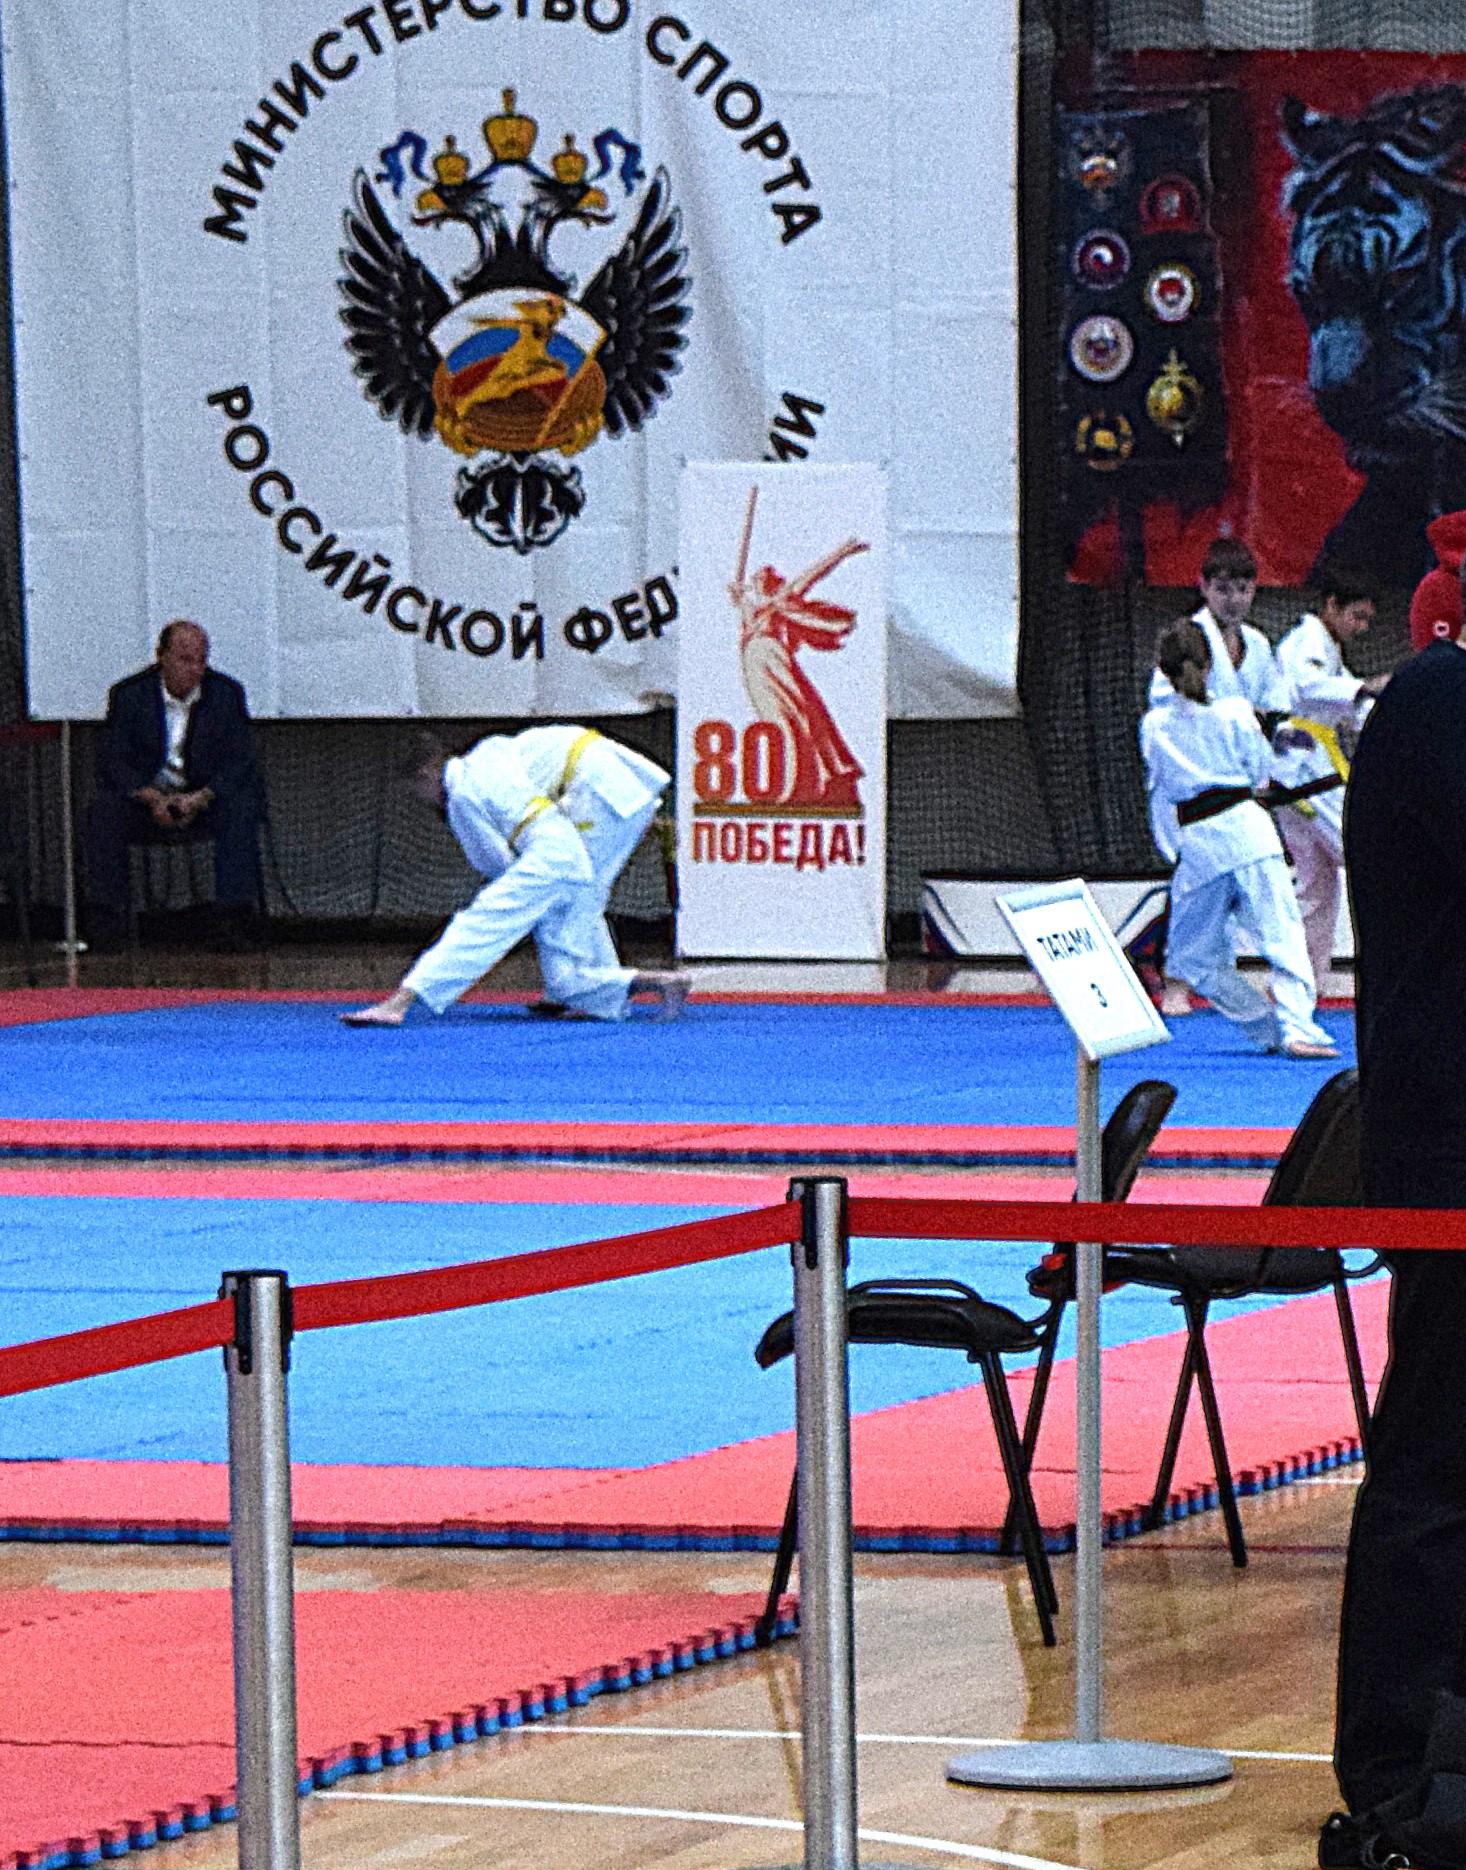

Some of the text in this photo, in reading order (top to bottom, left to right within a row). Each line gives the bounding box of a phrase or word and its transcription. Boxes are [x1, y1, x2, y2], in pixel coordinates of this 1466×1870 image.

[646, 15, 823, 246] СПОРТА
[208, 385, 545, 660] РОССИЙСКОЙ
[694, 720, 785, 802] 80
[693, 821, 866, 872] ПОБЕДА!
[1037, 927, 1098, 962] ТАТАМИ
